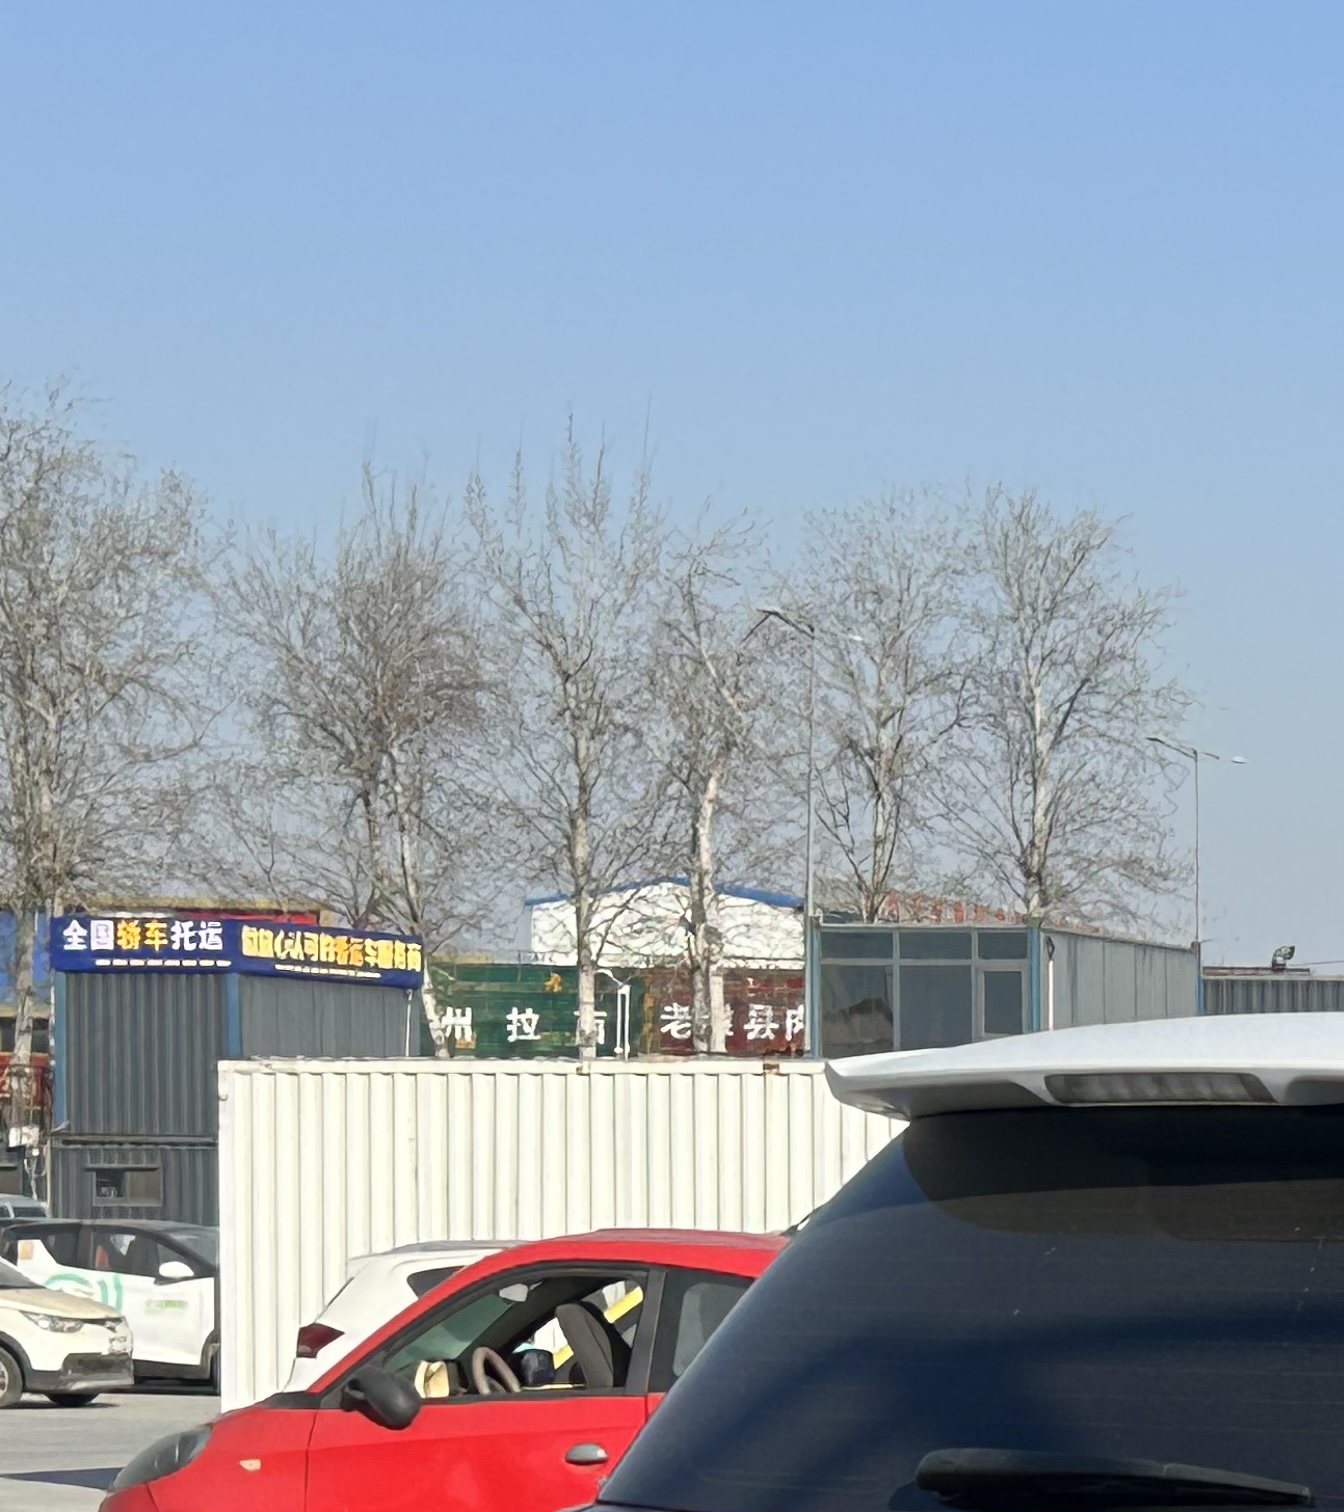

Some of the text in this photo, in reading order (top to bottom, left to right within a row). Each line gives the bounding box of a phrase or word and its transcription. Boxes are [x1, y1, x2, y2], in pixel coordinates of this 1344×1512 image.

[62, 919, 223, 951] 全国轿车托运
